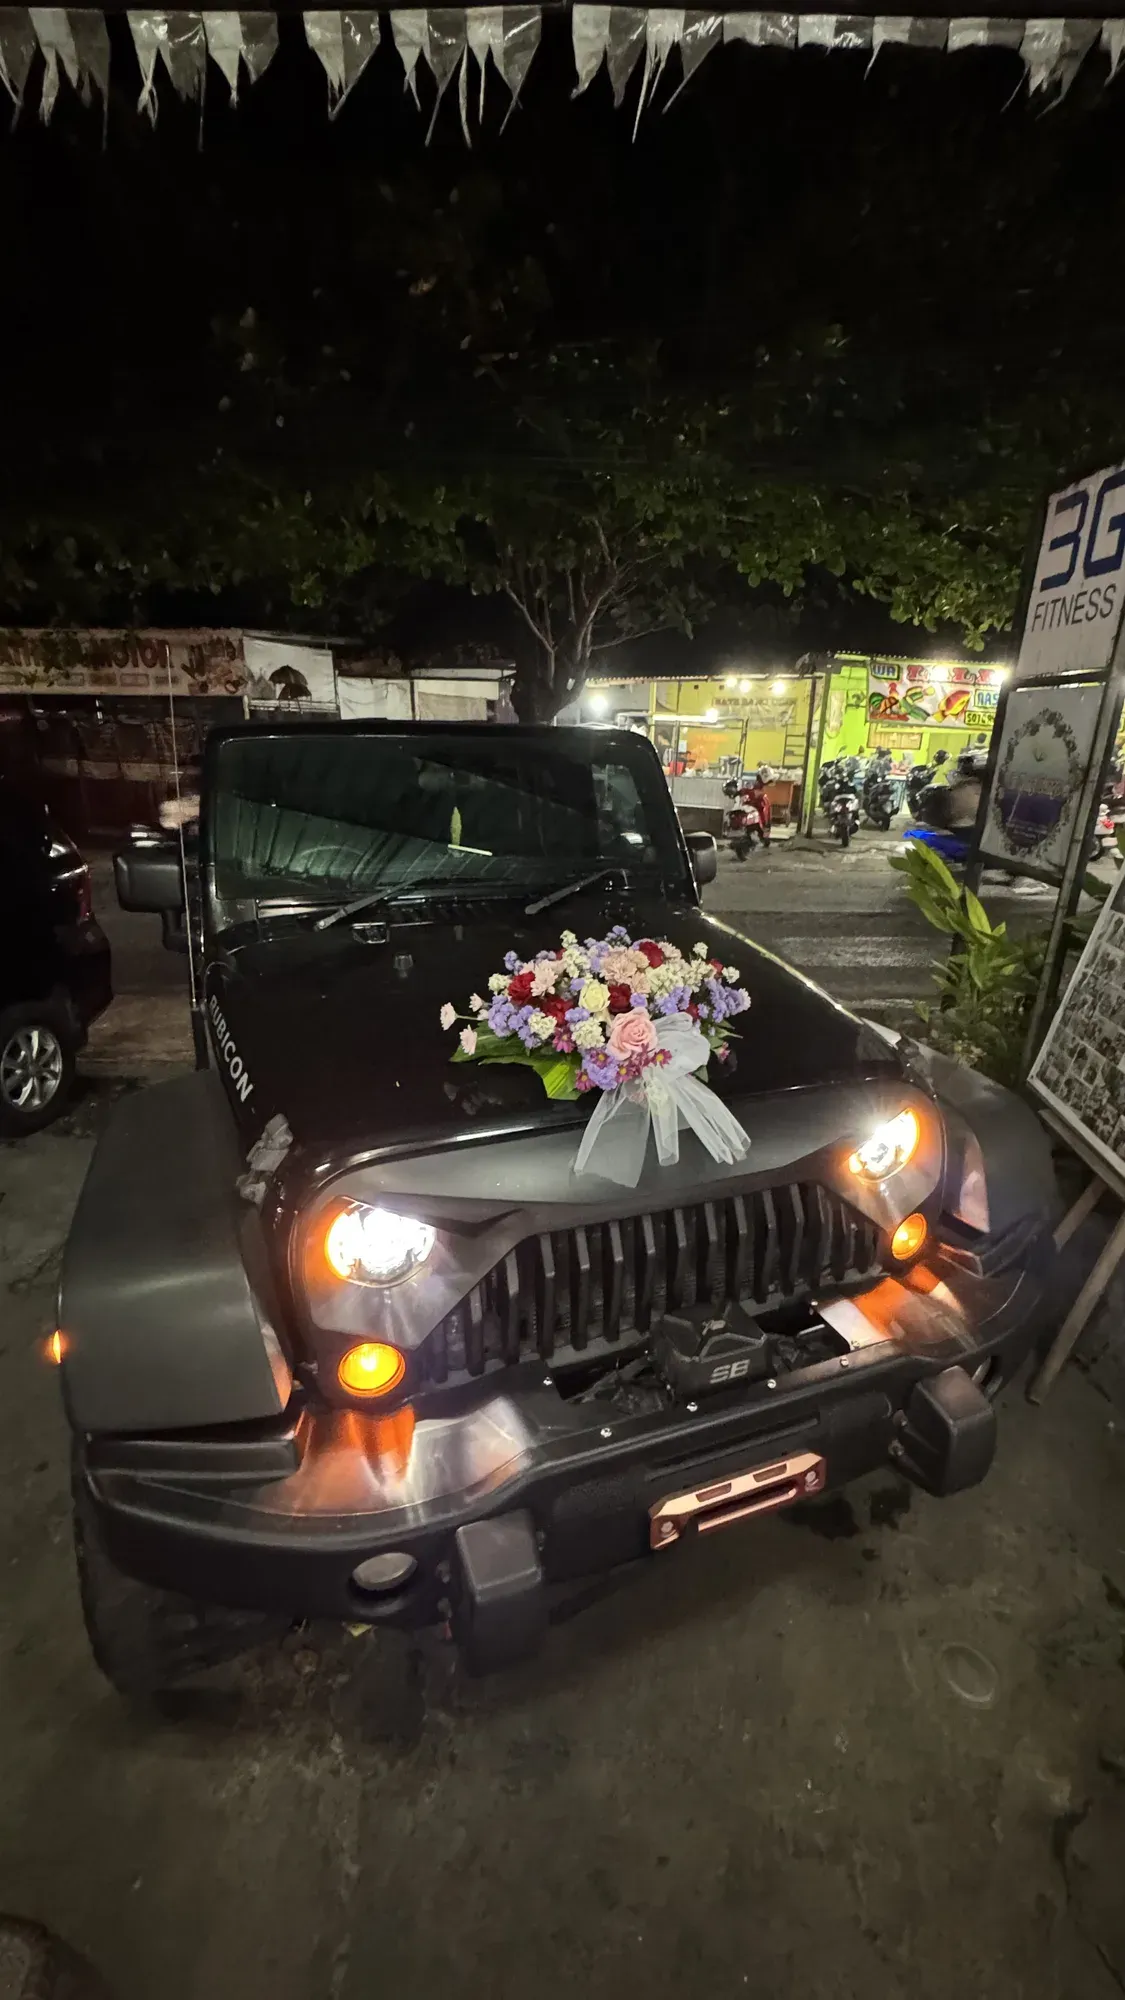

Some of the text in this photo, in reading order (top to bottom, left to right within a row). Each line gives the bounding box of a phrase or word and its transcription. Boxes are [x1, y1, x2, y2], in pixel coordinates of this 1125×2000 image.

[1040, 470, 1125, 592] 3G
[1031, 583, 1117, 633] FITNESS
[209, 994, 254, 1102] RUBICON
